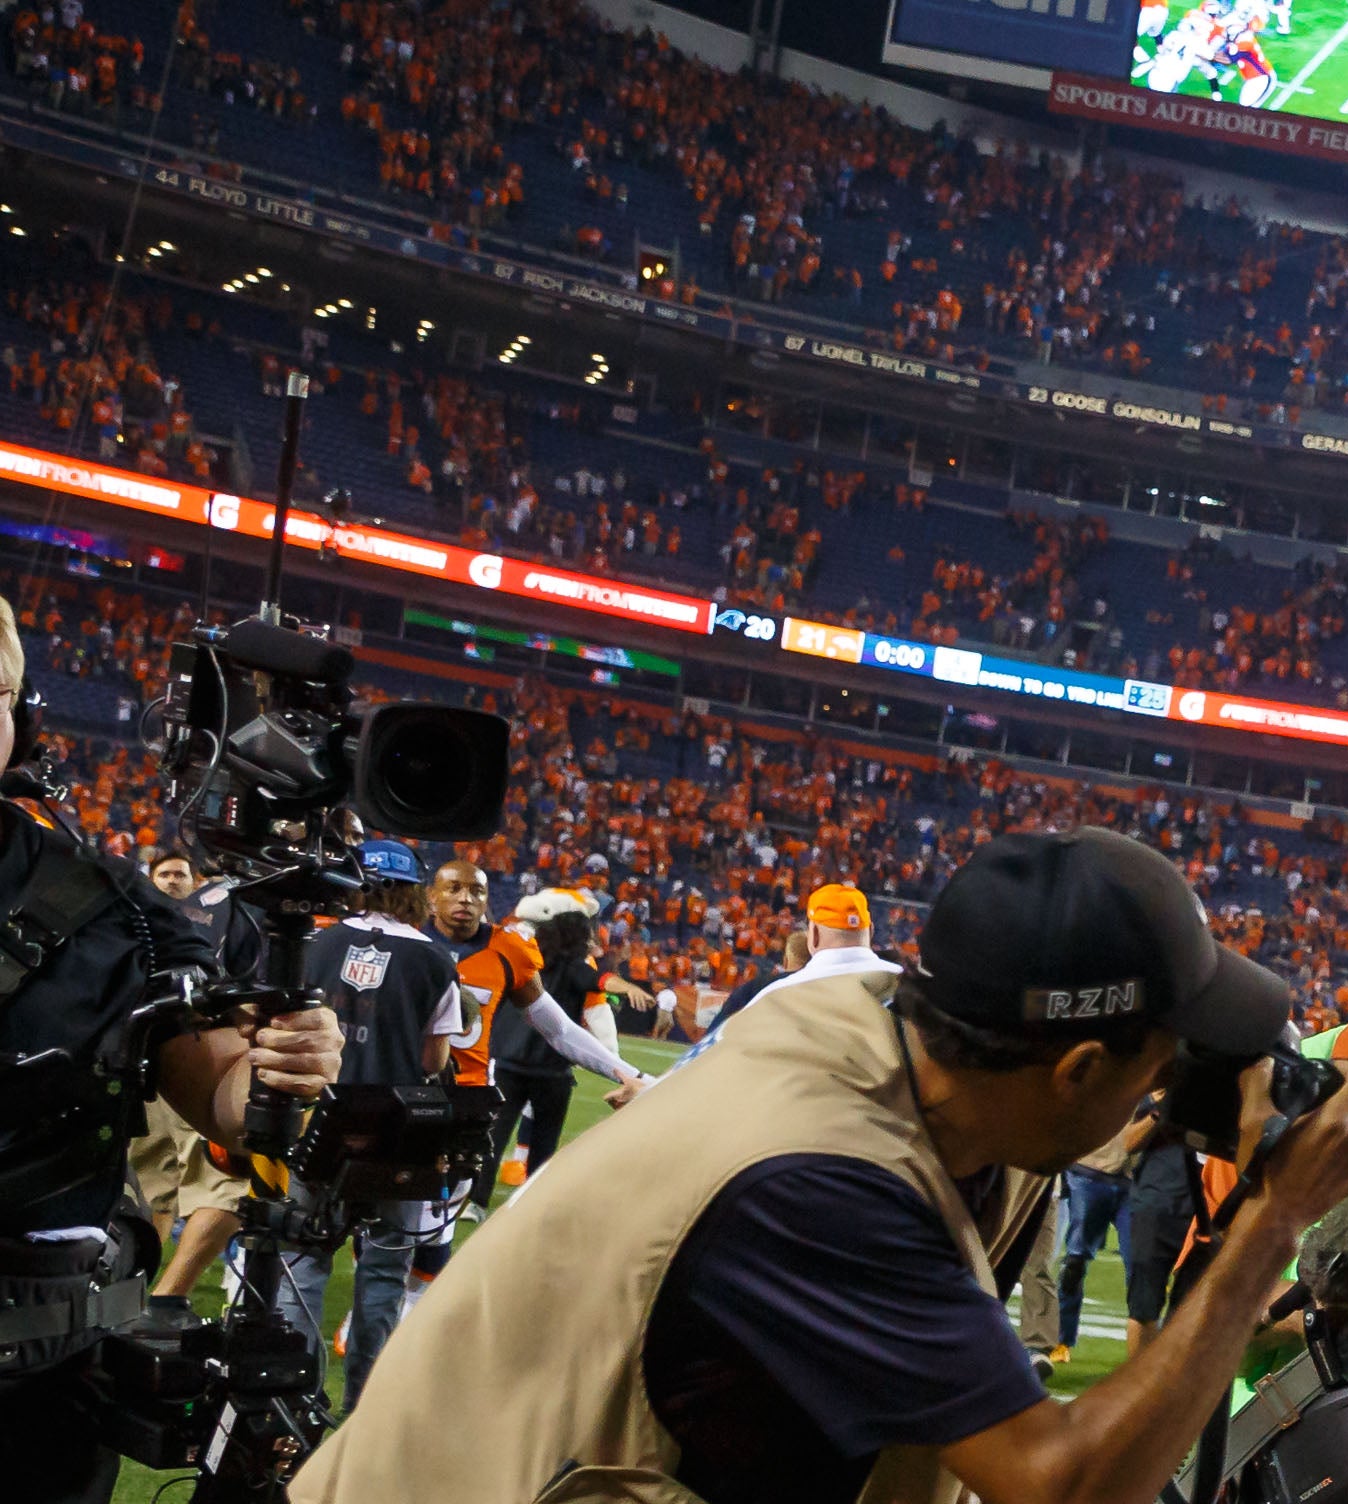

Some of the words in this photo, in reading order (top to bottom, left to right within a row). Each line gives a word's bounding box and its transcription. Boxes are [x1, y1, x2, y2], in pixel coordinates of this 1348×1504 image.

[1054, 83, 1147, 117] SPORTS
[1151, 102, 1302, 145] AUTHORITY
[155, 168, 179, 187] 44
[189, 177, 247, 207] FLOYD
[256, 197, 314, 227] LITTLE
[569, 282, 648, 315] JACKSON
[468, 554, 503, 588] G
[743, 616, 776, 641] 20
[797, 626, 826, 651] 21
[874, 641, 926, 669] 0:00
[1179, 691, 1206, 722] G
[349, 961, 377, 984] NFL
[1047, 983, 1135, 1019] RZN
